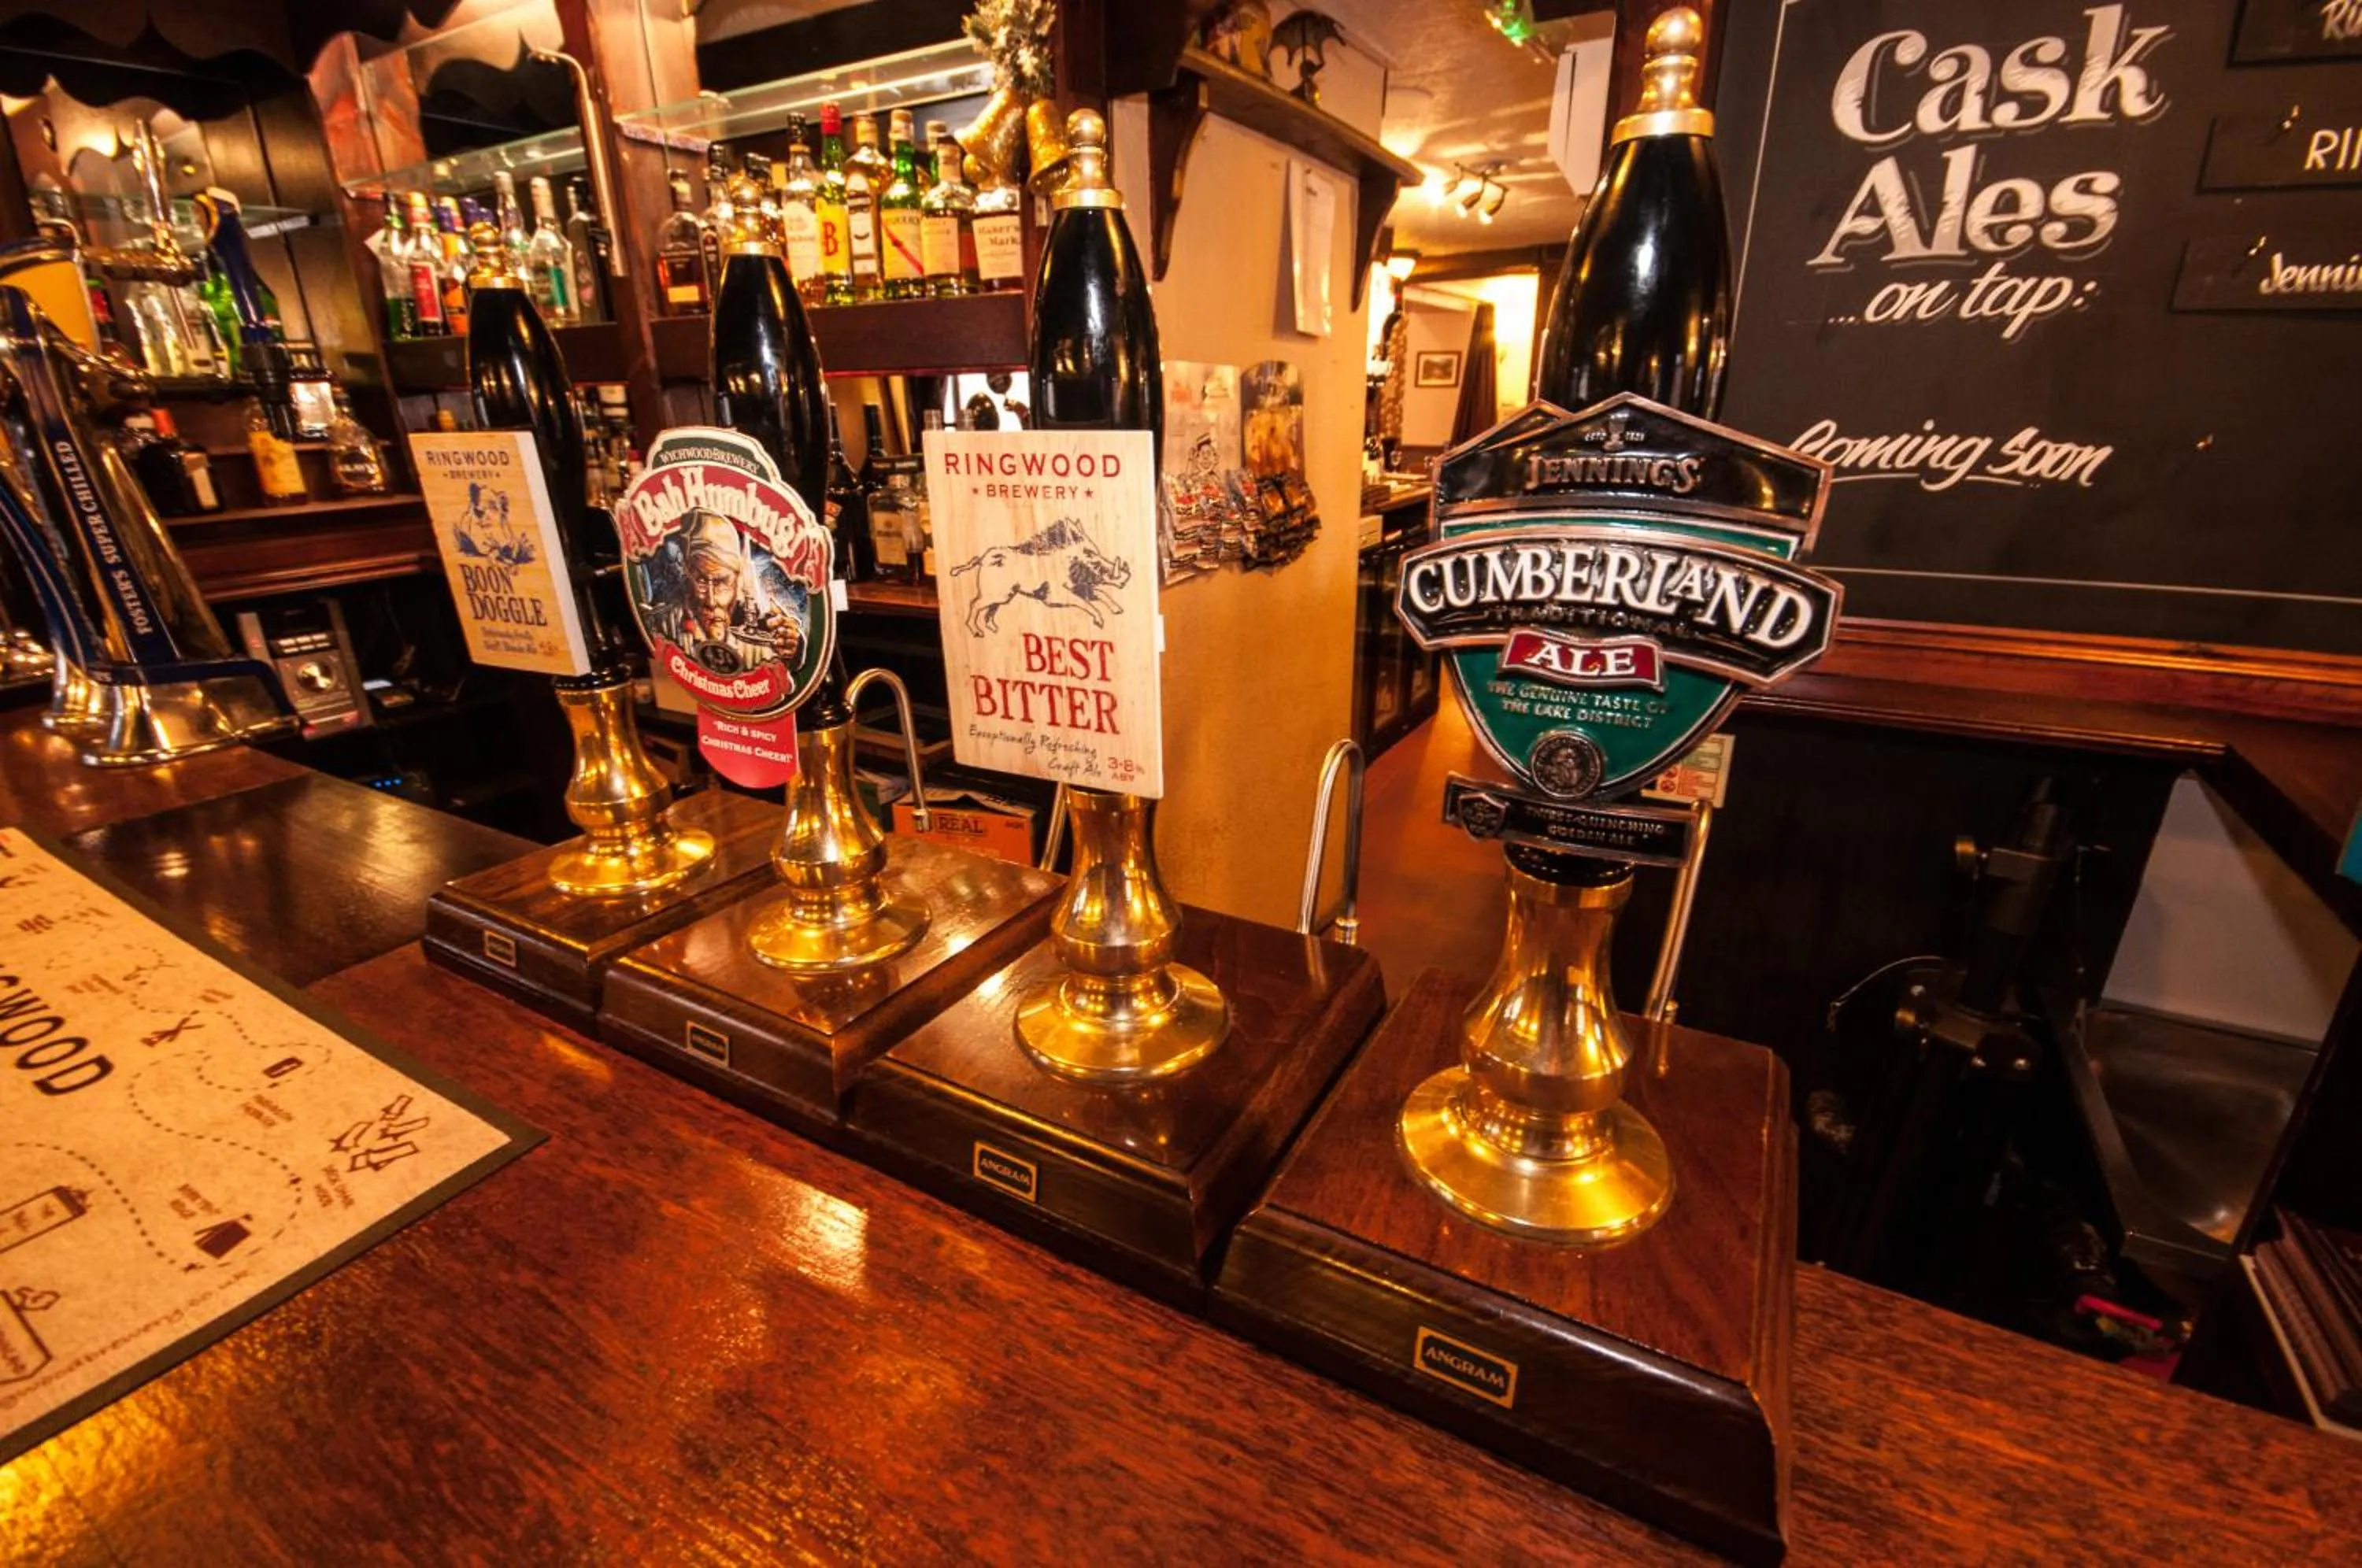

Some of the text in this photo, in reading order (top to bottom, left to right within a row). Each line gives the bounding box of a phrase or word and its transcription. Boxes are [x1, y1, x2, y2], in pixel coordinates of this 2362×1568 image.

[1833, 3, 2170, 142] Cask
[1806, 144, 2122, 266] Ales
[2259, 252, 2362, 295] Jenni
[1959, 261, 2097, 338] tap:
[426, 450, 510, 466] RINGWOOD
[944, 452, 1121, 478] RINGWOOD
[1524, 454, 1701, 494] JENNINGS
[1788, 420, 2114, 491] Coming Soon
[633, 475, 690, 536] Bah
[986, 483, 1079, 500] BREWERY
[54, 440, 154, 635] FOSTER'S SUPER CHILLED
[457, 563, 515, 594] BOON
[1408, 546, 1812, 649] CUMBERLAND
[467, 593, 548, 627] DOGGLE
[670, 655, 771, 700] Christmas Cheer
[1022, 633, 1115, 682] BEST
[1524, 640, 1638, 678] ALE
[970, 674, 1120, 735] BITTER
[1501, 698, 1653, 729] THE LAKE DISTRICT
[1519, 682, 1590, 705] GENUINE
[1593, 691, 1641, 712] TASTE
[969, 723, 1098, 760] Exceptionally Refreshing
[1047, 756, 1102, 778] Craft Ale
[938, 815, 984, 834] REAL
[1425, 1346, 1505, 1389] ANGRAM
